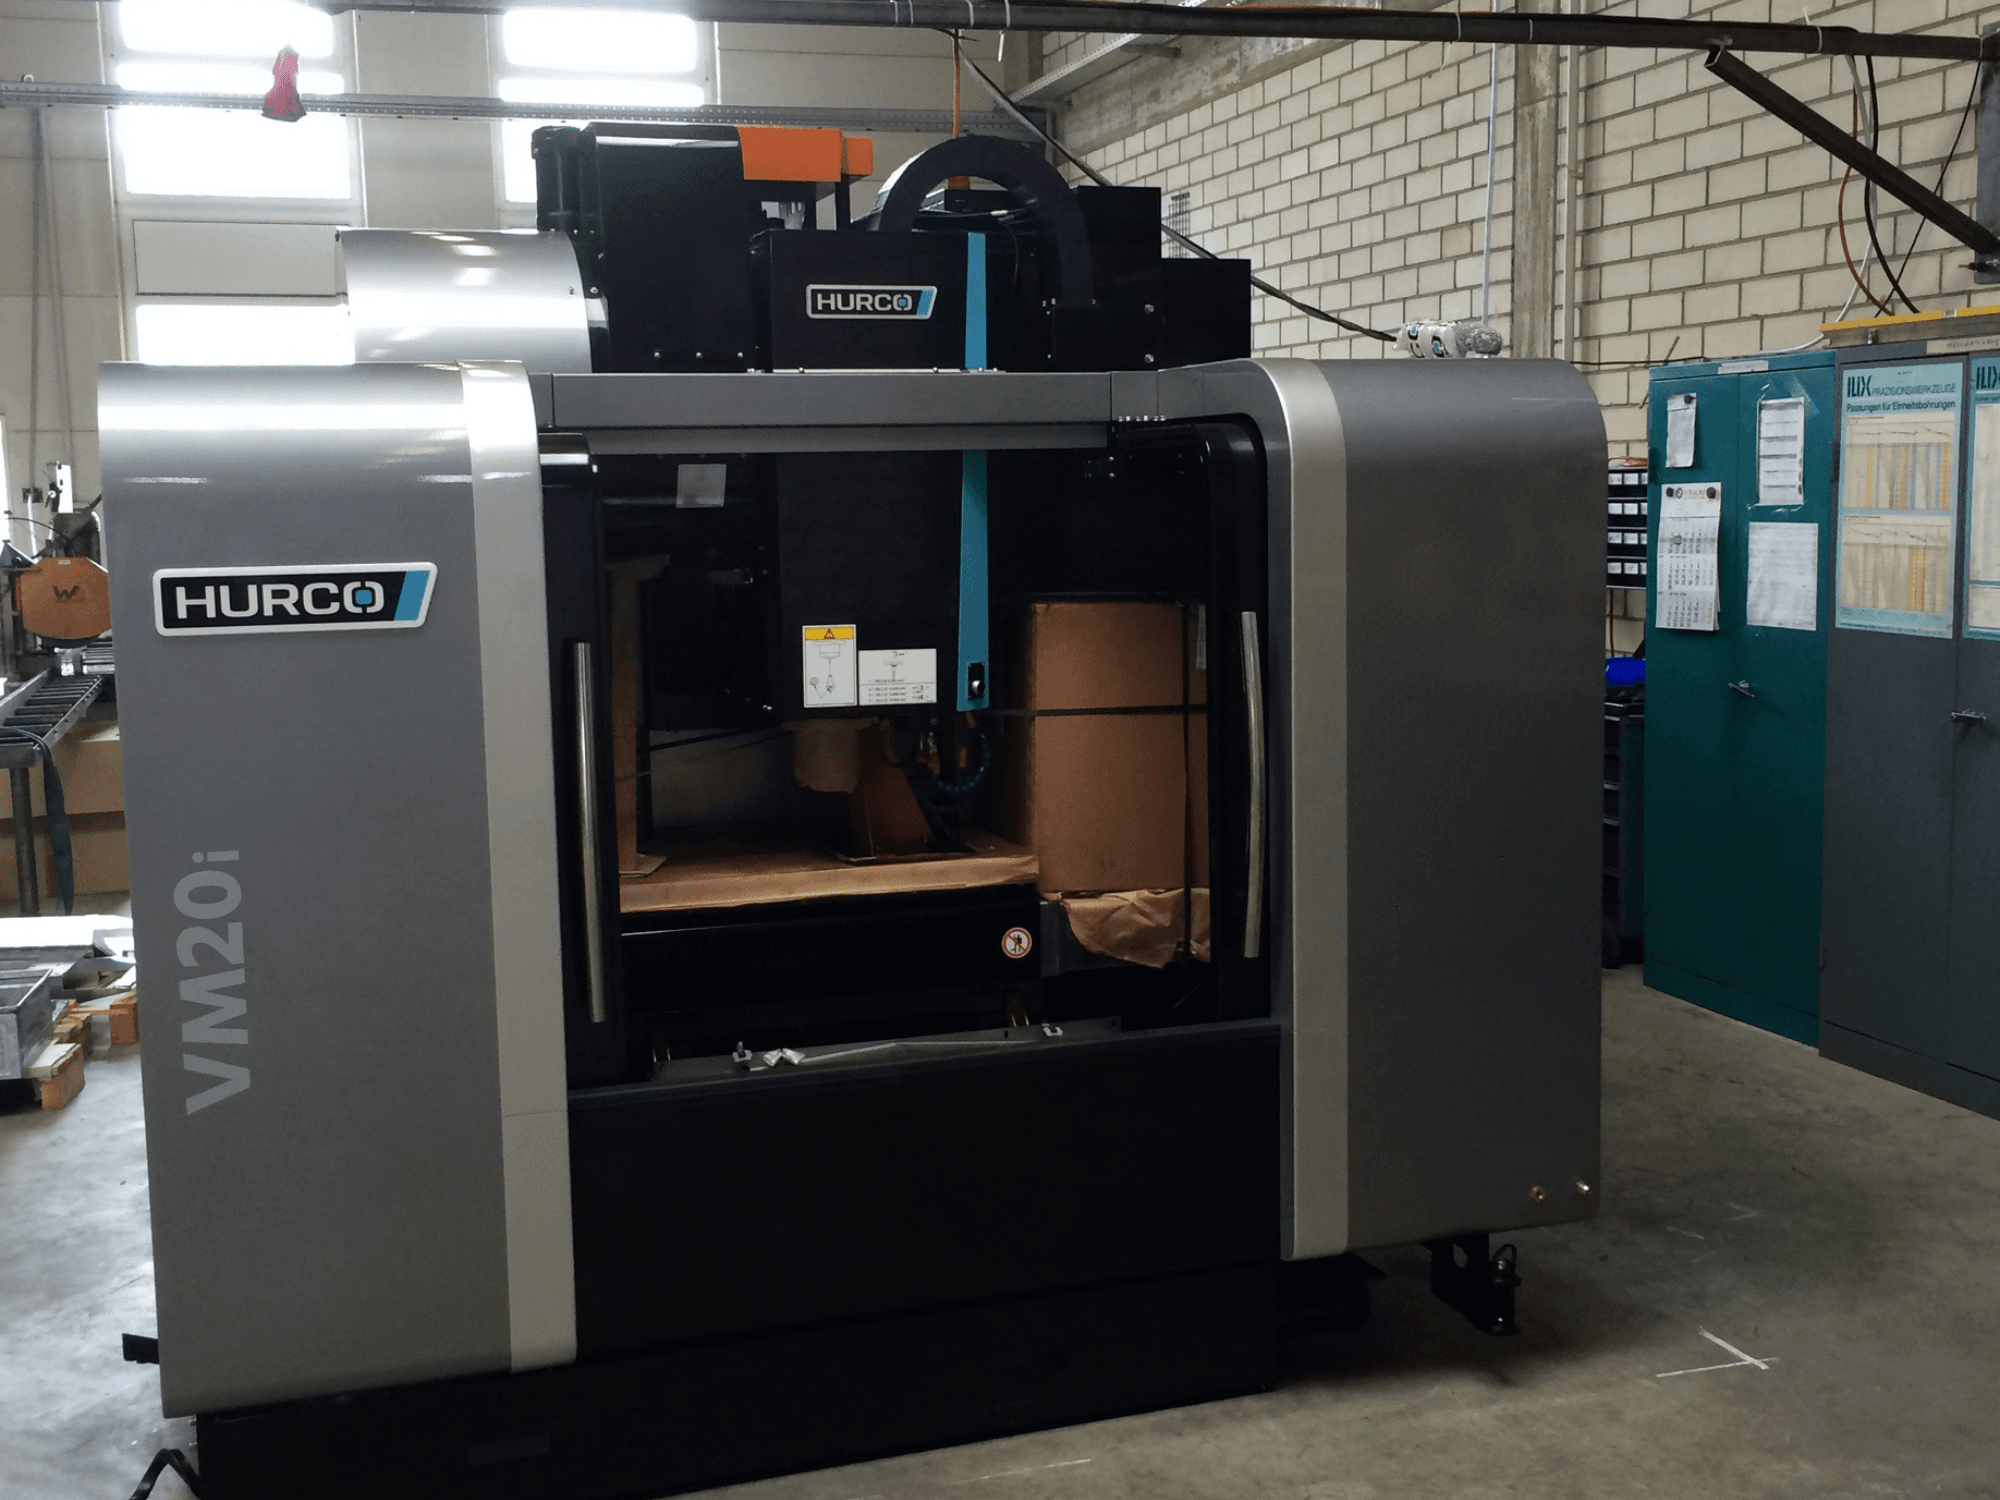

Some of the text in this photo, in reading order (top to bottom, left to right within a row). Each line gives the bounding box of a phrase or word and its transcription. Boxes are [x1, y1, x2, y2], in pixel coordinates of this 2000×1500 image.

[817, 293, 912, 311] HURCO
[1847, 375, 1872, 397] ILIX
[1846, 403, 1881, 413] Passungen
[1892, 400, 1956, 411] Einheitsbohrungen
[176, 581, 385, 619] HURCO
[173, 850, 250, 1115] VM20i
